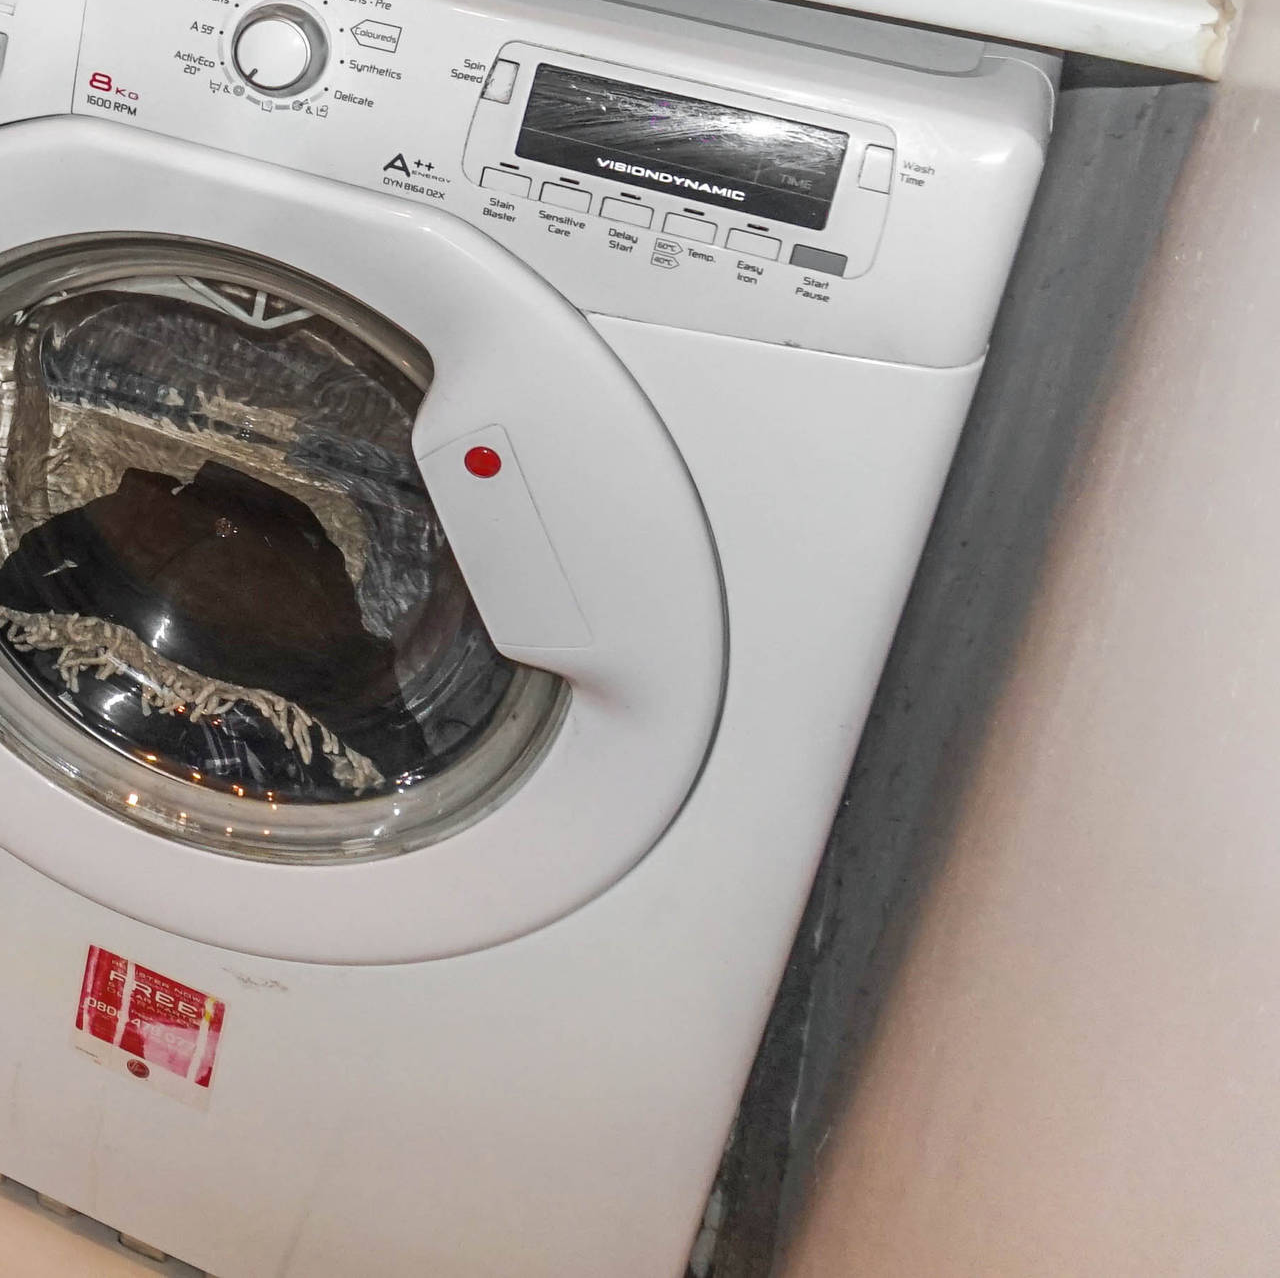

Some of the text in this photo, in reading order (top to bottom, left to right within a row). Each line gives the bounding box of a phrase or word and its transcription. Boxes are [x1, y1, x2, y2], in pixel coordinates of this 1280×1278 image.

[354, 27, 397, 44] Coloureds
[174, 50, 215, 68] ActivEco
[463, 59, 486, 72] Spin
[349, 59, 402, 80] Synthetics
[450, 68, 483, 83] Speed
[87, 94, 137, 116] 1600 RPM
[334, 90, 374, 108] Delicate
[903, 160, 936, 175] Wash
[596, 157, 746, 202] VISIONDYNAMIC
[780, 174, 813, 189] TIME
[900, 172, 926, 187] Time
[489, 197, 515, 211] Stain
[482, 207, 517, 223] Blaster
[538, 209, 586, 230] Sensitive
[547, 224, 571, 237] Care
[608, 227, 638, 244] Delay
[608, 240, 634, 253] Start
[687, 248, 716, 263] Temp.
[736, 260, 764, 275] Easy
[737, 272, 758, 285] Iron
[803, 276, 830, 290] Start
[795, 287, 830, 303] Pause
